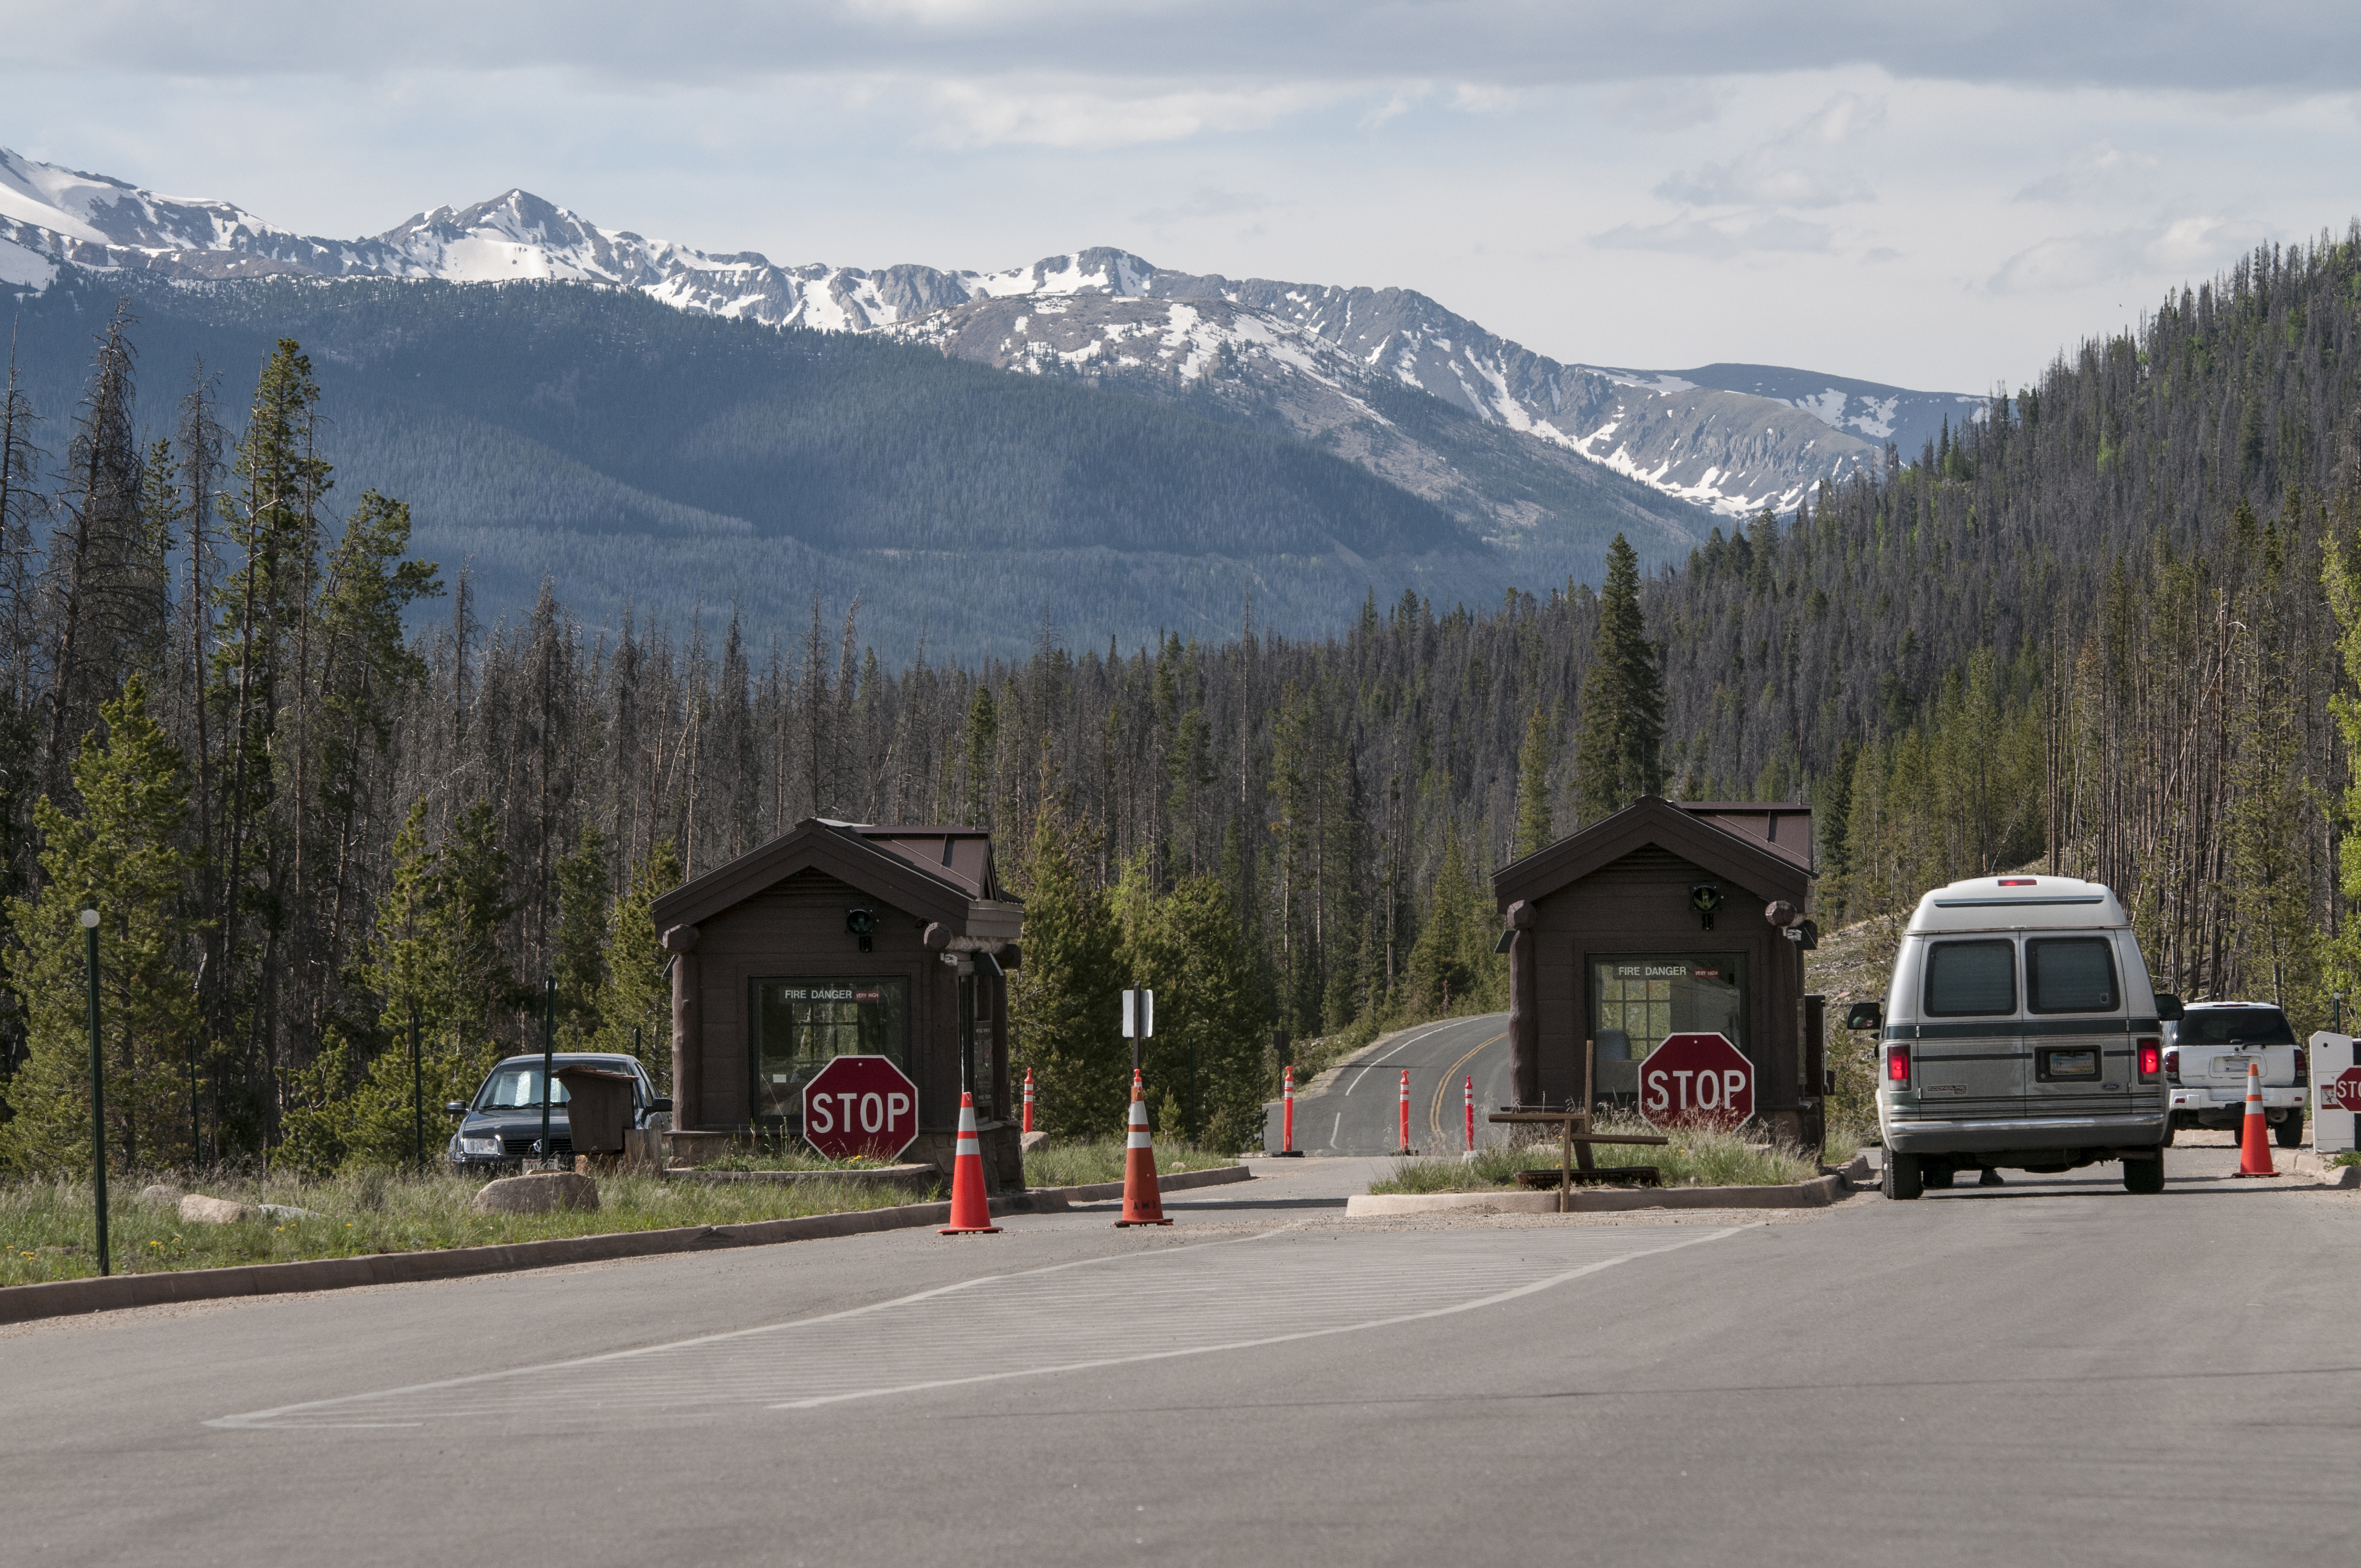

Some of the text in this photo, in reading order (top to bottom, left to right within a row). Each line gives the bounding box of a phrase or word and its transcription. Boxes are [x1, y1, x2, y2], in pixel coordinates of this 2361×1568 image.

[1619, 966, 1687, 976] FIRE DANGER
[785, 989, 852, 999] FIRE DANGER
[1647, 1069, 1746, 1110] STOP
[2336, 1080, 2361, 1099] ST
[812, 1092, 910, 1134] STOP
